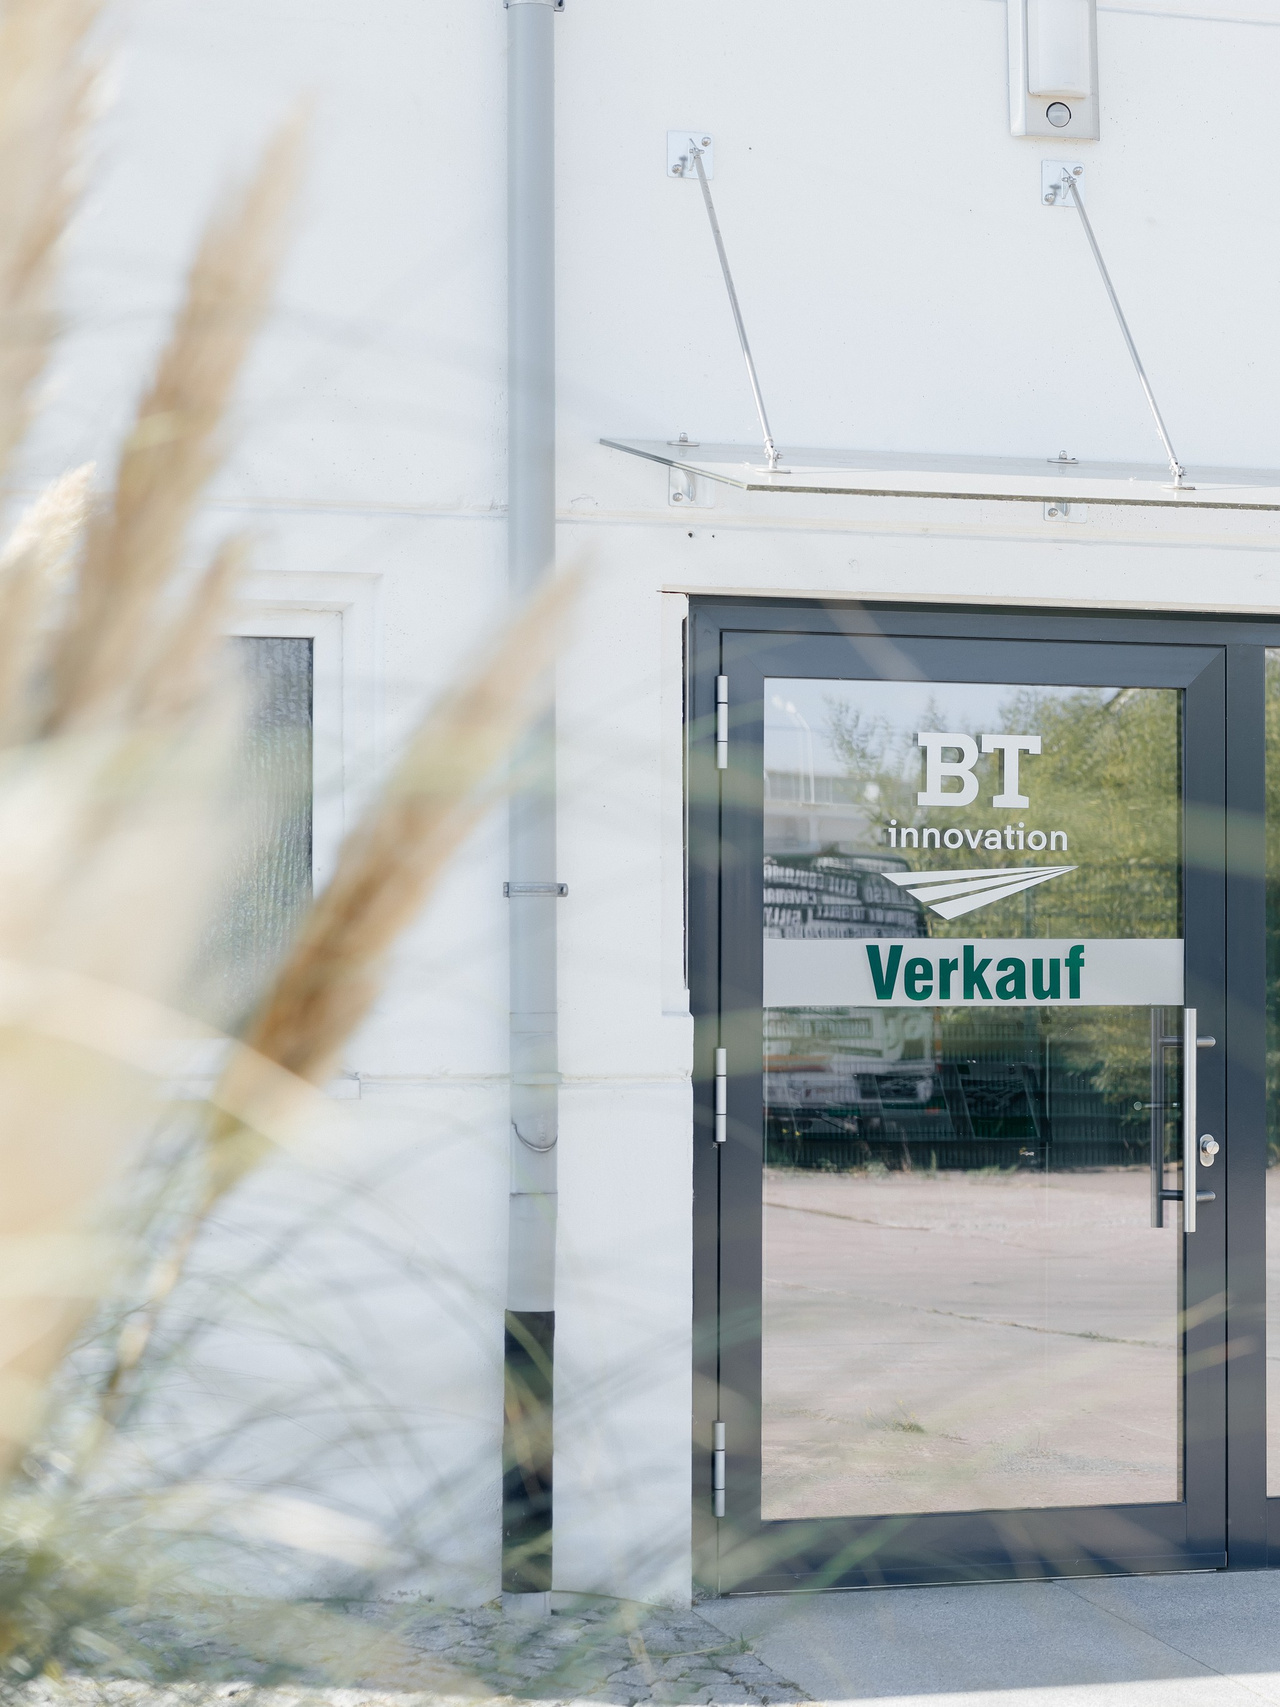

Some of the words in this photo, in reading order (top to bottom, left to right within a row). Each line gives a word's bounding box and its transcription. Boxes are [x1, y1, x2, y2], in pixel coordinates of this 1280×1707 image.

[917, 732, 1042, 808] BT
[888, 819, 1068, 851] innovation
[865, 944, 1085, 1001] Verkauf
